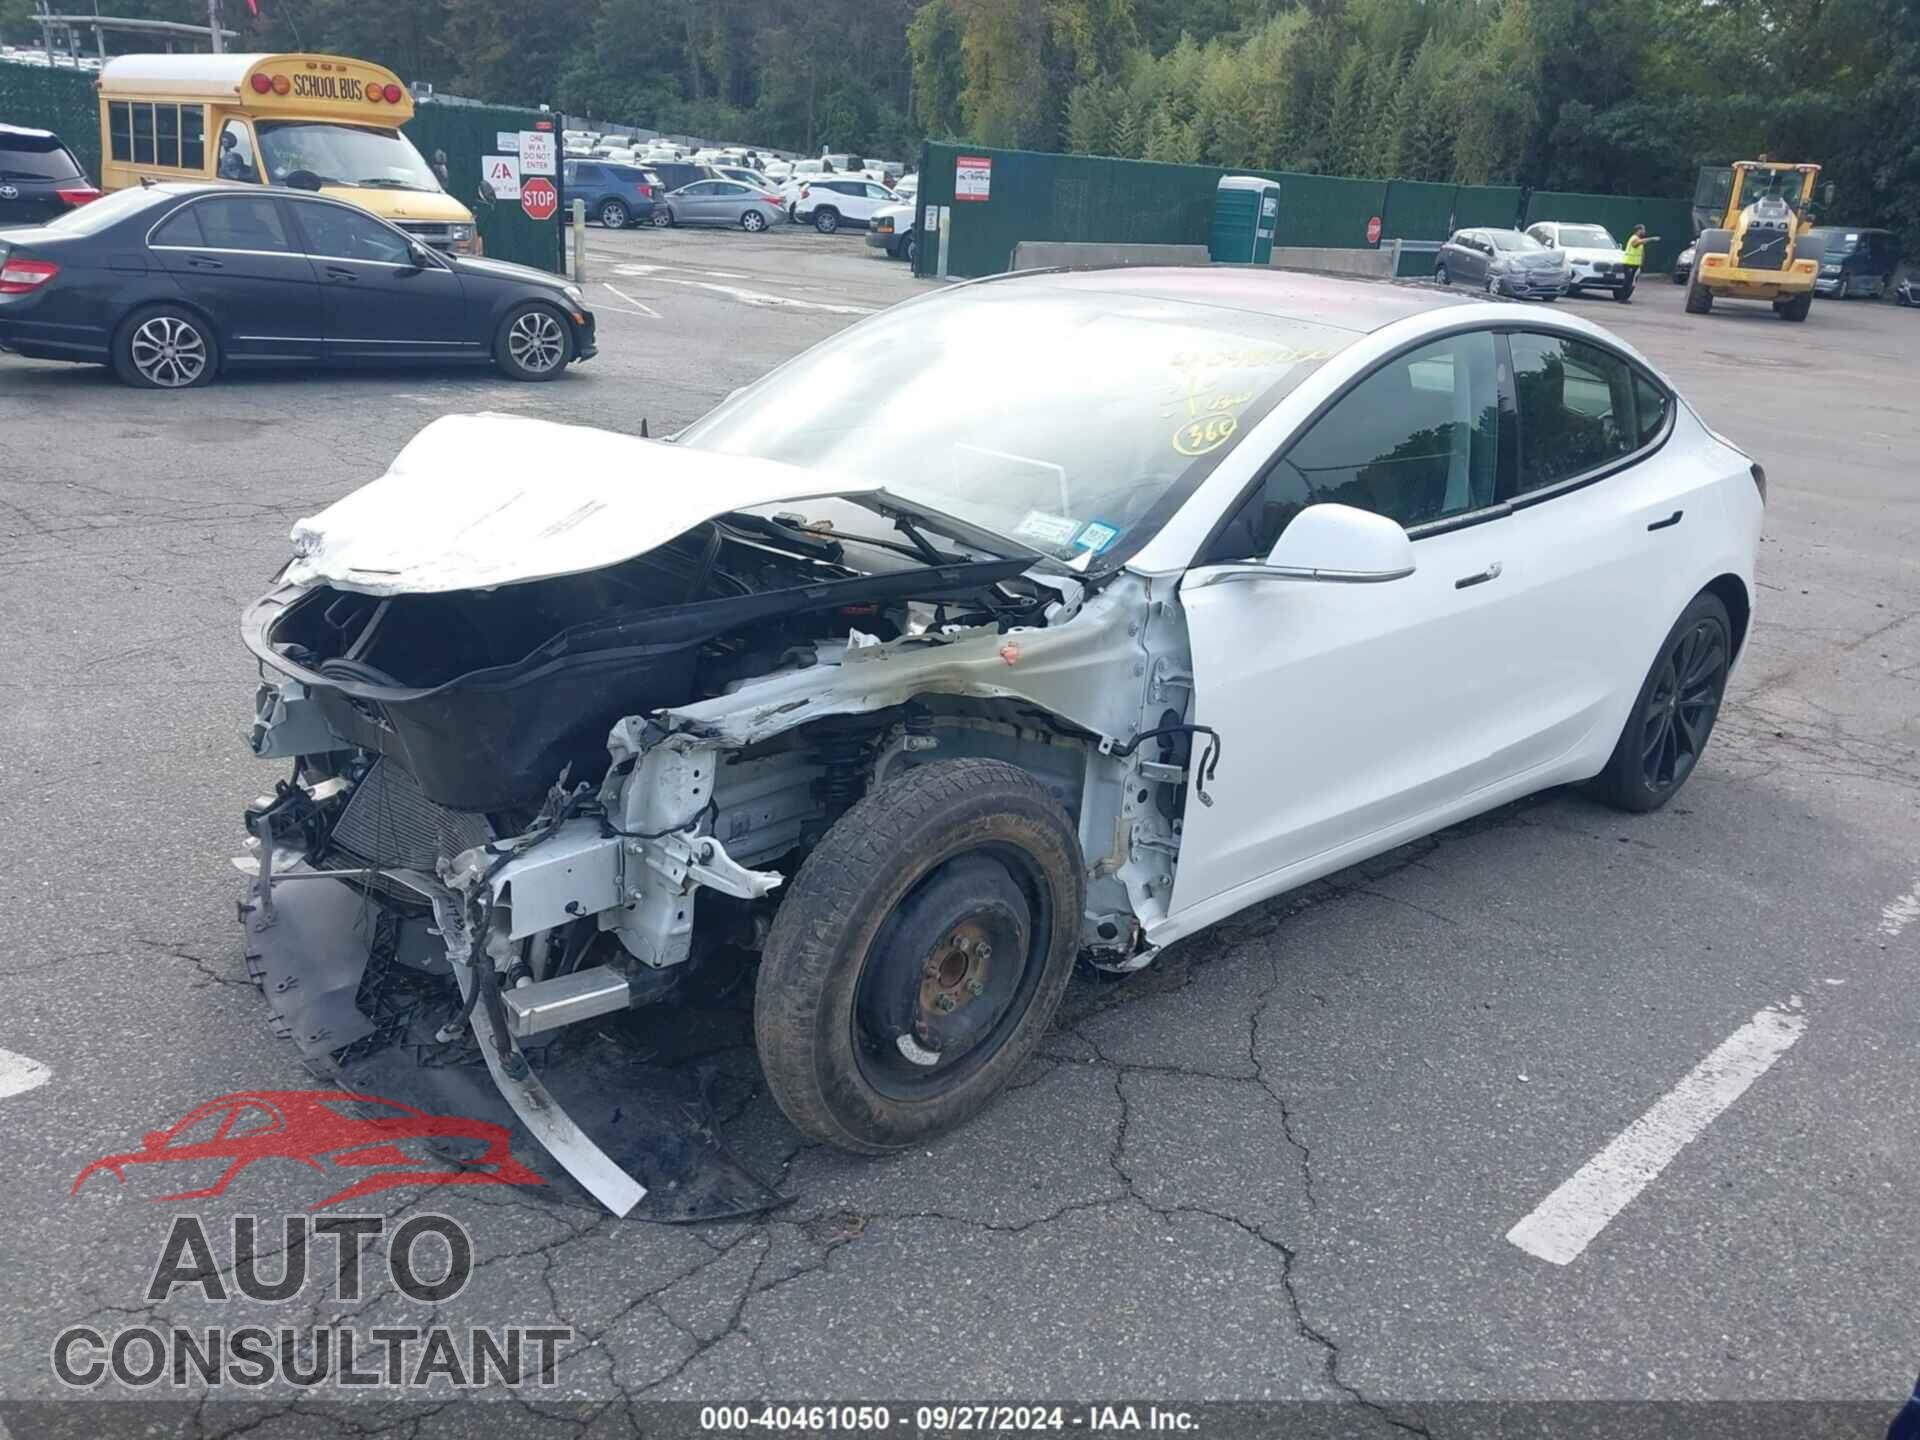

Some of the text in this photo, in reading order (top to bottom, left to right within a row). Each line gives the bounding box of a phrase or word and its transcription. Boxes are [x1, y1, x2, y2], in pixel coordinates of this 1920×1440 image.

[294, 74, 362, 100] SCHOOL BUS
[523, 152, 551, 161] DO NOT
[526, 161, 548, 169] ENTER
[523, 190, 554, 207] STOP
